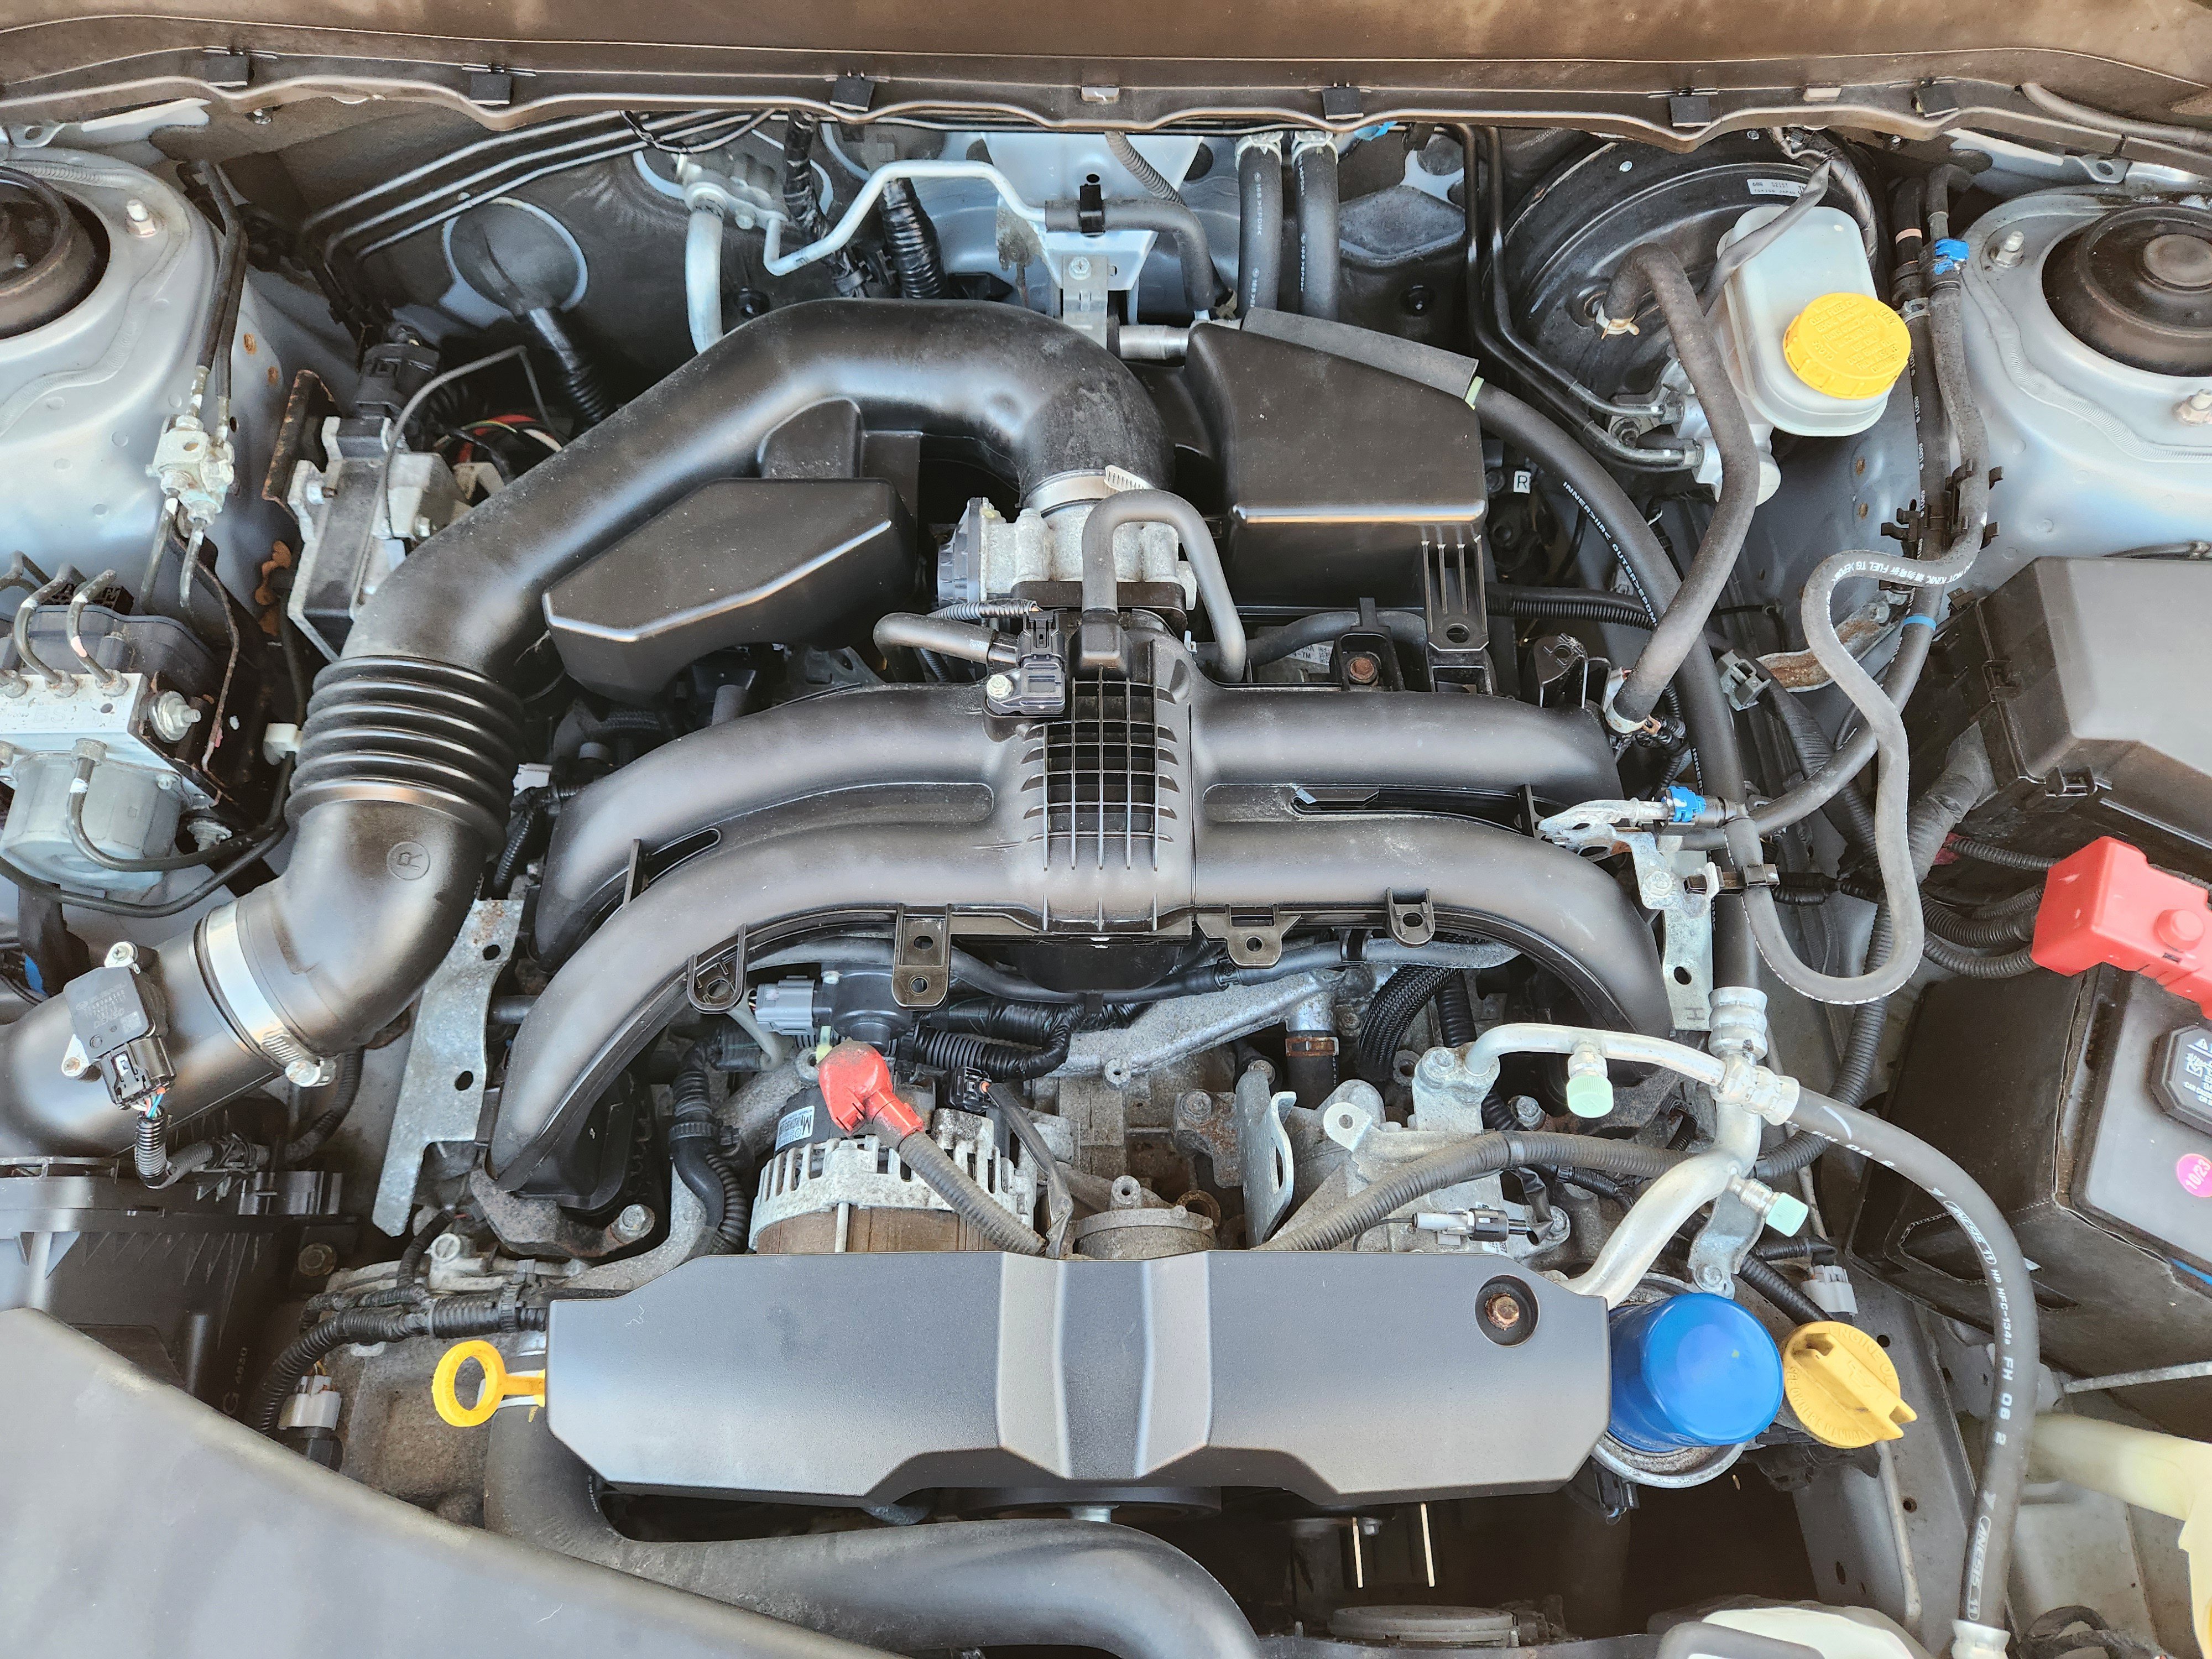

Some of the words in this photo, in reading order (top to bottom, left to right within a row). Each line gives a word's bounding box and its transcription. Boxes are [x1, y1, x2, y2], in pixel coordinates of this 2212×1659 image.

[1812, 340, 1835, 361] CLOSE
[1516, 475, 1528, 489] R
[1856, 561, 1866, 571] TG
[1869, 561, 1890, 574] FUEL
[2185, 1159, 2211, 1190] 10/23
[1991, 1268, 2002, 1284] HP
[1828, 1324, 1883, 1361] ENGINE
[2002, 1356, 2014, 1381] FH
[1786, 1366, 1799, 1384] SEE
[1824, 1425, 1867, 1444] MANUAL
[1995, 1431, 2006, 1446] 2
